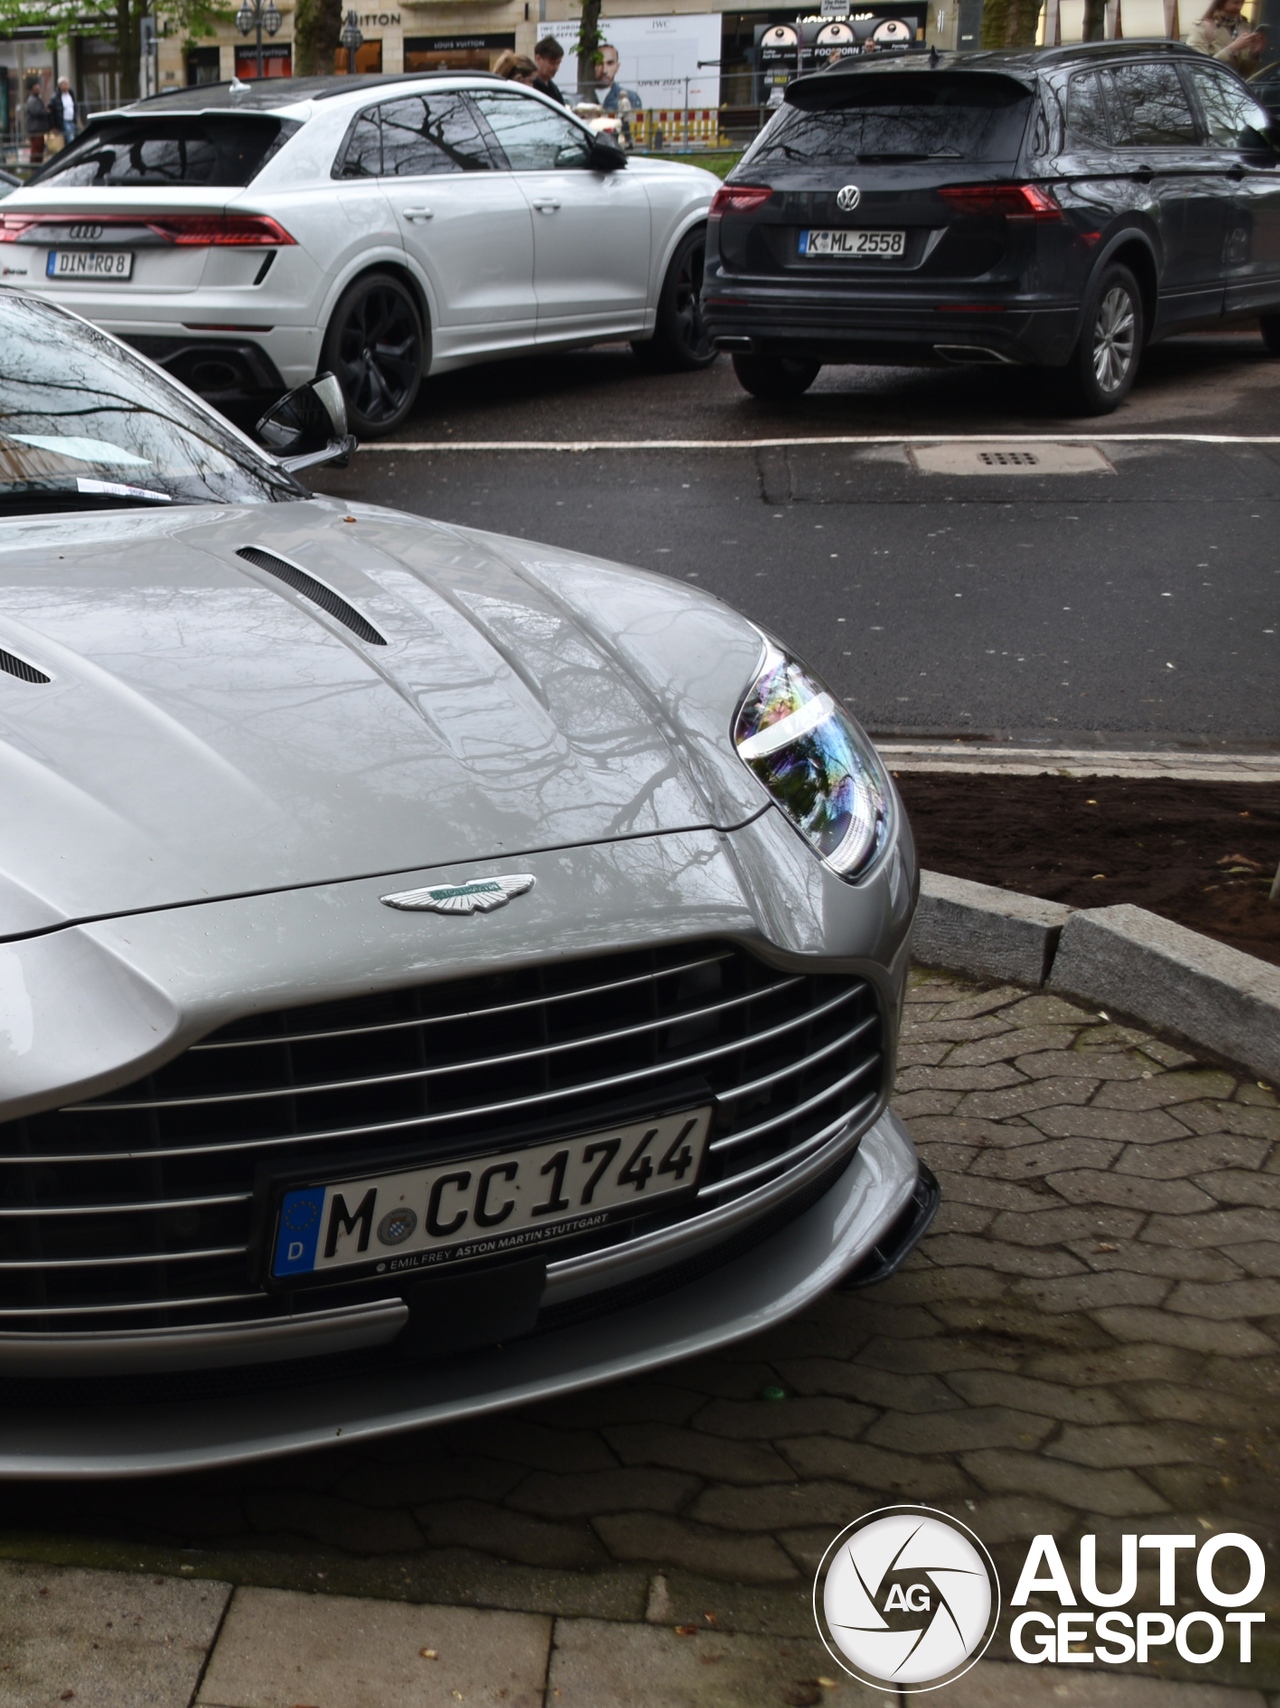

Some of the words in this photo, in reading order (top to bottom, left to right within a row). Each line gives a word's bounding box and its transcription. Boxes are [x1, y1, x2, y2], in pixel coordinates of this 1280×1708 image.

[808, 232, 820, 251] K
[830, 232, 853, 252] ML
[856, 233, 903, 253] 2558
[60, 254, 88, 271] DIN
[94, 255, 114, 272] RQ
[116, 255, 126, 273] 8
[323, 1186, 378, 1258] M
[425, 1161, 519, 1237] CC
[531, 1117, 699, 1217] 1744
[287, 1241, 304, 1260] D
[390, 1256, 419, 1270] EMIL
[421, 1249, 452, 1264] FREY
[455, 1239, 495, 1258] ASTON
[498, 1229, 543, 1249] MARTIN
[544, 1212, 609, 1238] STUTTGART
